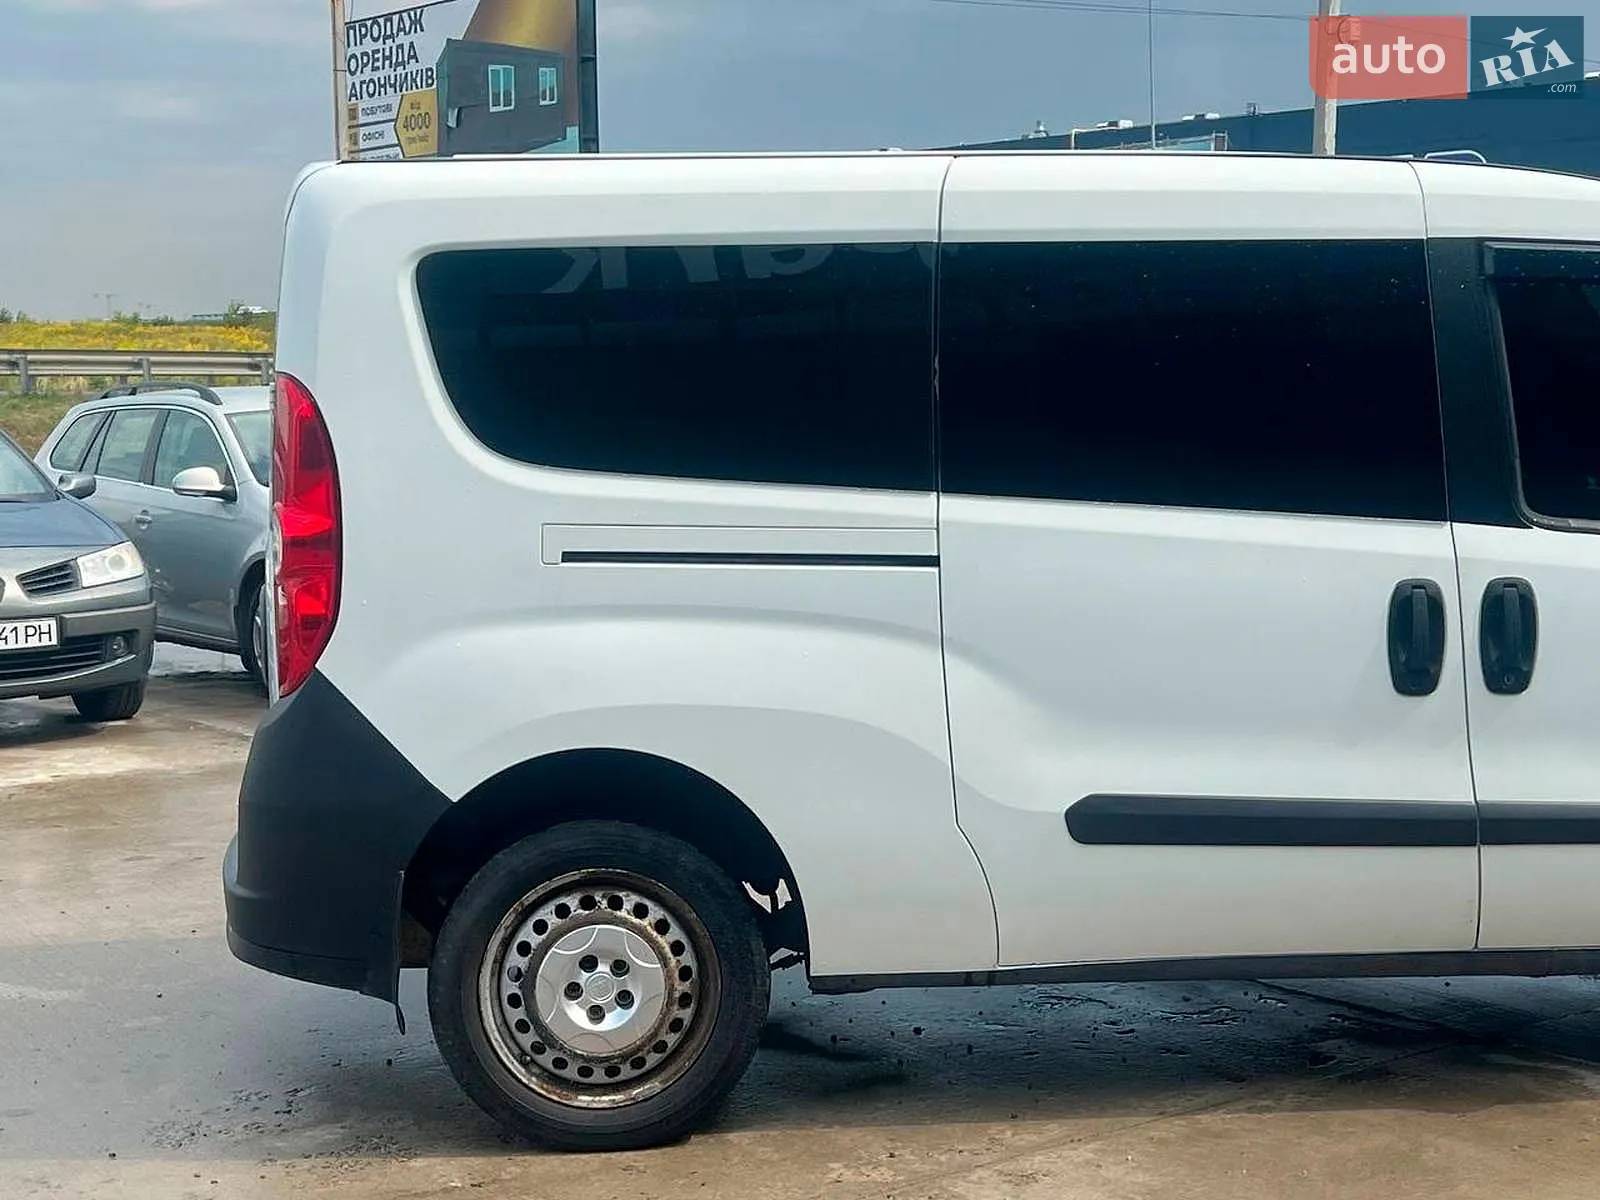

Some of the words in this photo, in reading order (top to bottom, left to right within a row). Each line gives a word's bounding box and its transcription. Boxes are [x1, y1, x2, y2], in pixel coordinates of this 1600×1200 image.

[346, 8, 424, 48] ПРОДАЖ
[347, 40, 420, 77] ОРЕНДА
[403, 112, 431, 132] 4000
